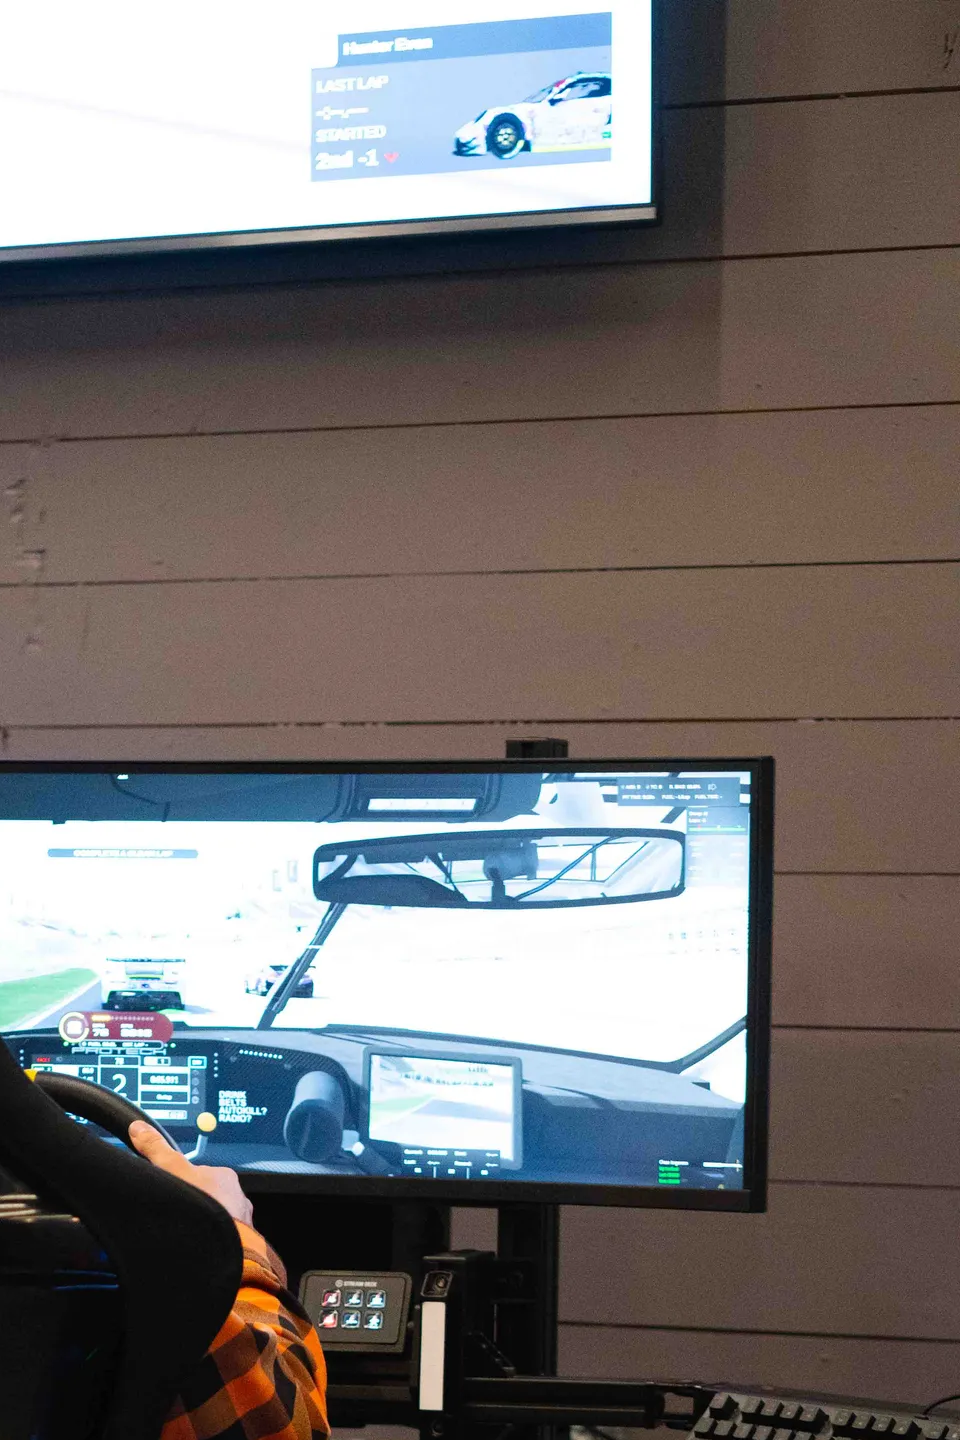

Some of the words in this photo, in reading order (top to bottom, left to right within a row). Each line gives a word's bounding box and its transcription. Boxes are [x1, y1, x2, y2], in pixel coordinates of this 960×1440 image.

[316, 77, 356, 93] LAST
[356, 75, 389, 90] LAP
[315, 125, 386, 142] STARTED
[112, 1074, 128, 1098] 2
[218, 1098, 247, 1107] BELTS
[218, 1114, 252, 1123] RADIO?
